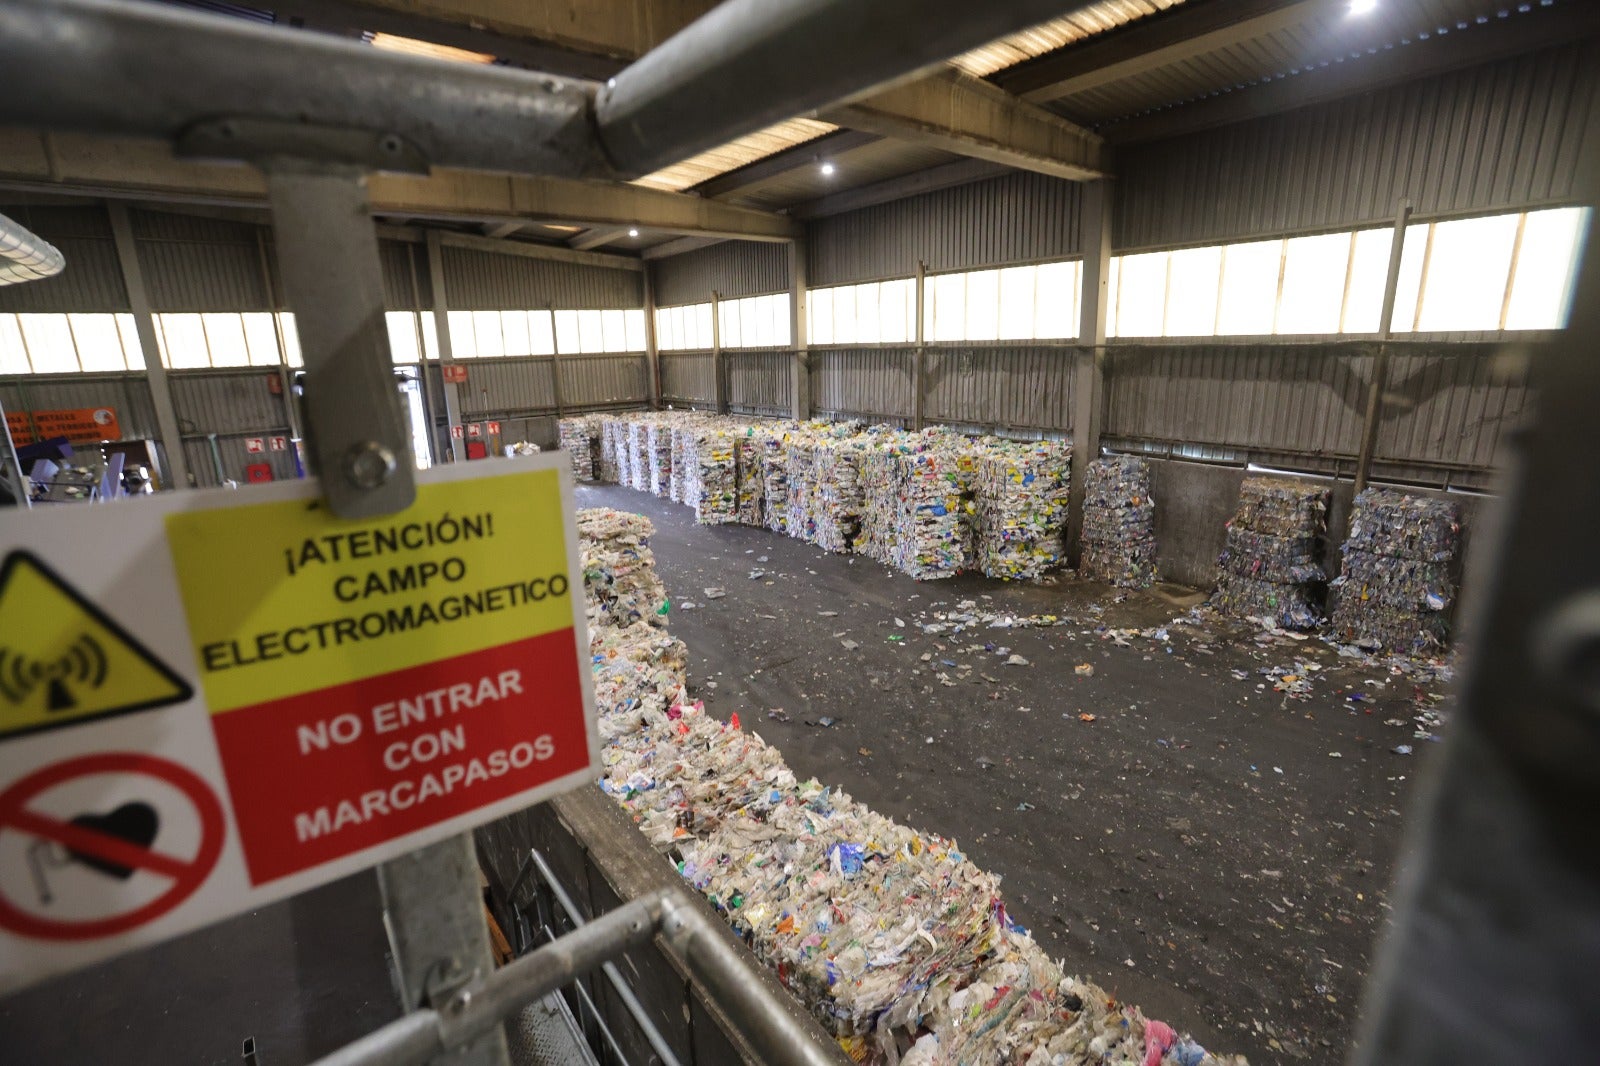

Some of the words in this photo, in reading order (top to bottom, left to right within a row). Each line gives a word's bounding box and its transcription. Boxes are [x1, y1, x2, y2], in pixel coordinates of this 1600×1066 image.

[285, 512, 495, 576] ¡ATENCIÓN!
[333, 557, 467, 603] CAMPO
[201, 574, 569, 673] ELECTROMAGNETICO
[296, 714, 363, 755] NO
[372, 669, 524, 734] ENTRAR
[383, 724, 467, 771] CON
[294, 735, 556, 842] MARCAPASOS
